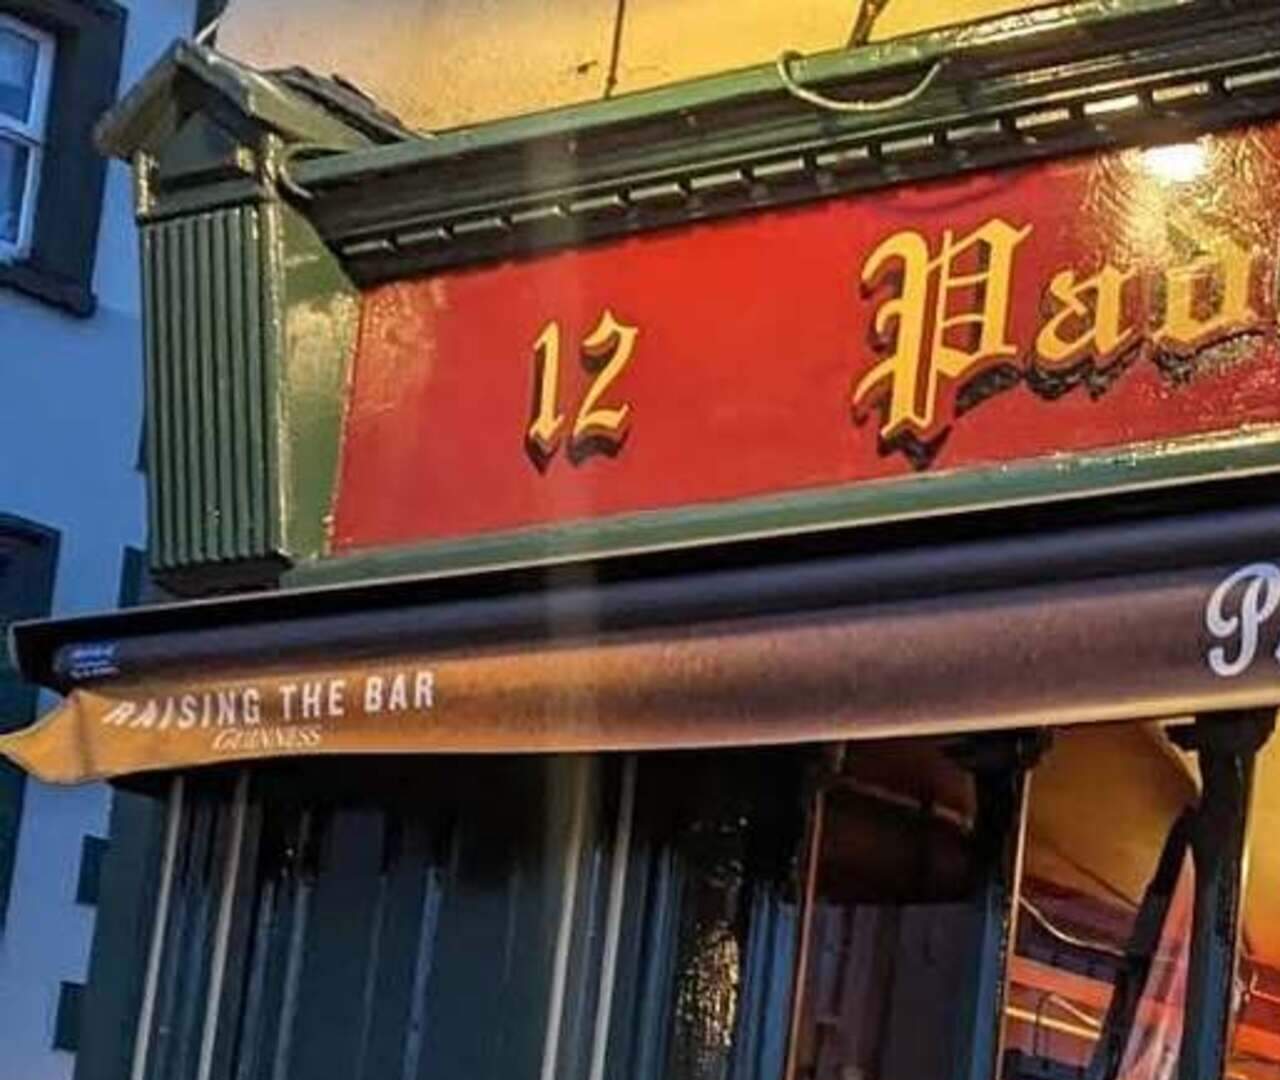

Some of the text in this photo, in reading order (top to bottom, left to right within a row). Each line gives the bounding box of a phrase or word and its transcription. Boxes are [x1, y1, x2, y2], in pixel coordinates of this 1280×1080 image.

[528, 306, 640, 458] 12
[102, 670, 435, 730] RAISING THE BAR
